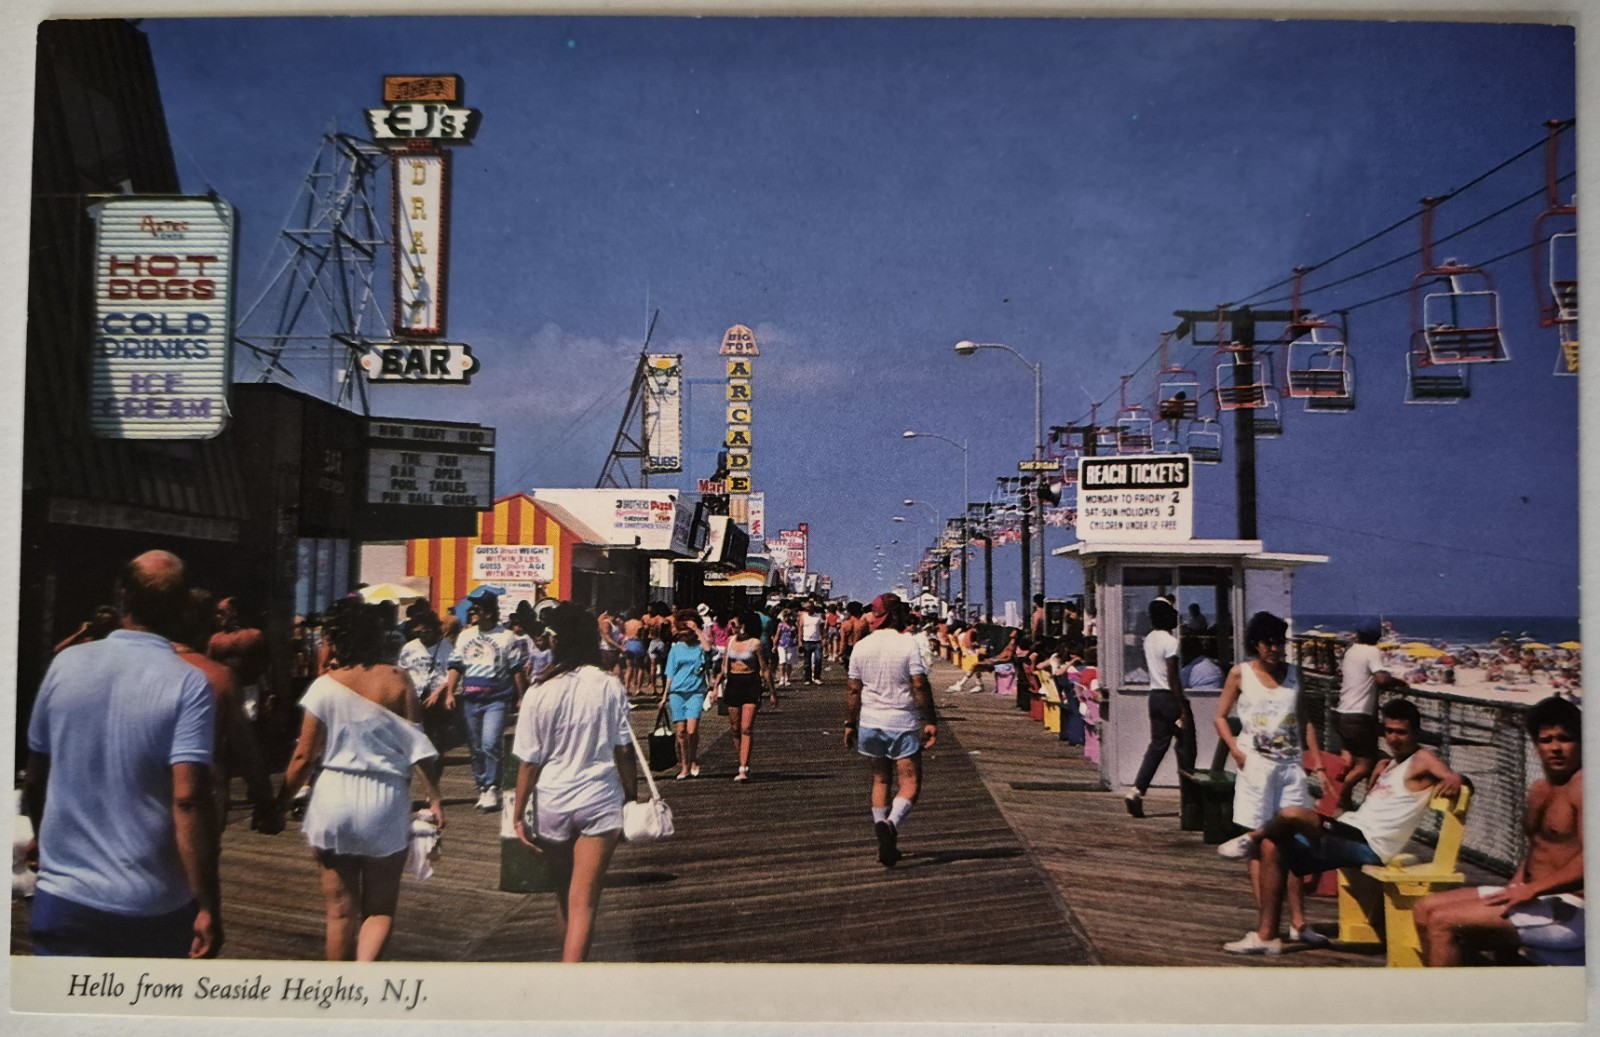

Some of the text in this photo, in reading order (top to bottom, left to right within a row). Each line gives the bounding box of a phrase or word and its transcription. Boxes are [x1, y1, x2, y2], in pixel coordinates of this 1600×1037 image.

[109, 254, 219, 277] HOT
[108, 278, 216, 301] DOGS
[103, 312, 212, 335] COLD
[101, 337, 210, 359] DRINKS
[725, 342, 755, 351] TOP
[728, 333, 751, 341] BIG
[381, 348, 452, 376] BAR
[131, 373, 183, 395] ICE
[101, 396, 212, 419] CREAM
[730, 361, 749, 491] ARCADE
[649, 456, 678, 467] SUBS
[434, 468, 462, 480] OPEN
[1086, 462, 1184, 485] BEACH TICKETS
[391, 479, 468, 493] POOL TABLES
[442, 494, 477, 506] GAMES
[1085, 491, 1180, 504] MONDAY TO FRIDAY 2
[1120, 507, 1160, 517] HOLIDAYS
[1168, 504, 1176, 517] 3
[1090, 520, 1123, 530] CHILDREN
[1125, 520, 1148, 530] UNDER
[1161, 520, 1177, 530] FREE
[68, 972, 428, 1010] Hello from Seaside Heights, N.J.
